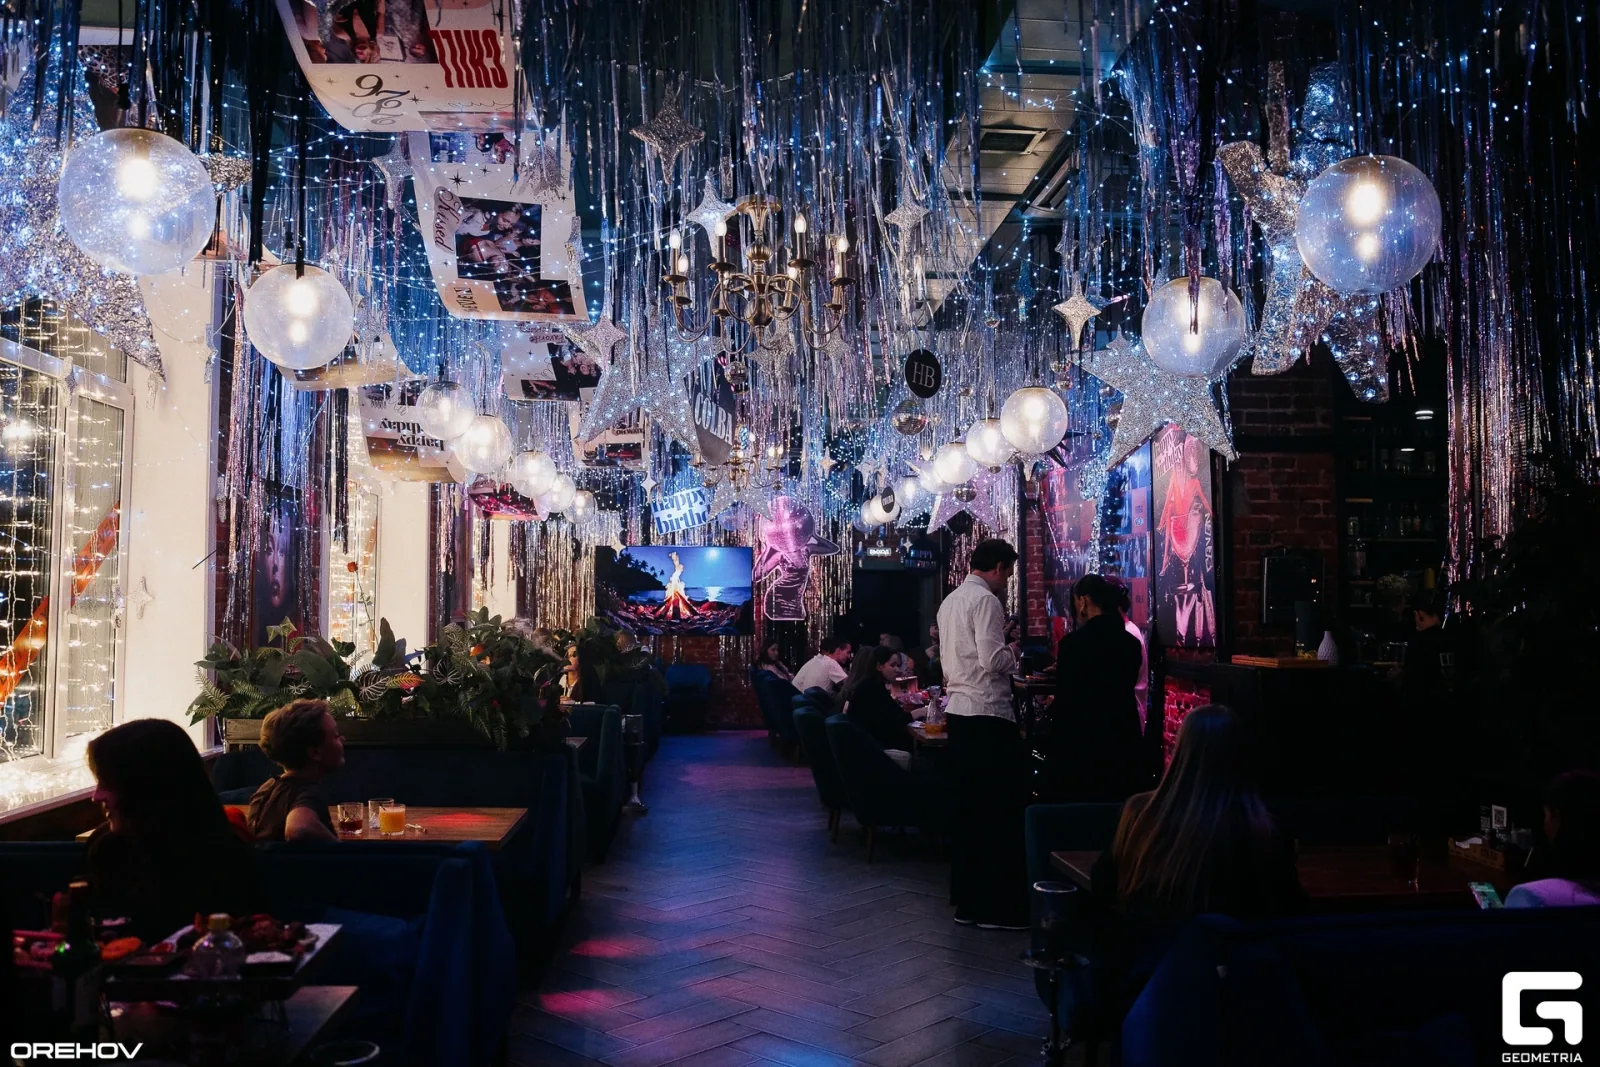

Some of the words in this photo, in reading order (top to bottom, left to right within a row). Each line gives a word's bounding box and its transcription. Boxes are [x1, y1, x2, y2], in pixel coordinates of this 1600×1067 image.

[429, 29, 508, 88] CHILL
[434, 189, 462, 252] Kissed
[911, 361, 935, 389] HB
[694, 392, 733, 446] COLBA
